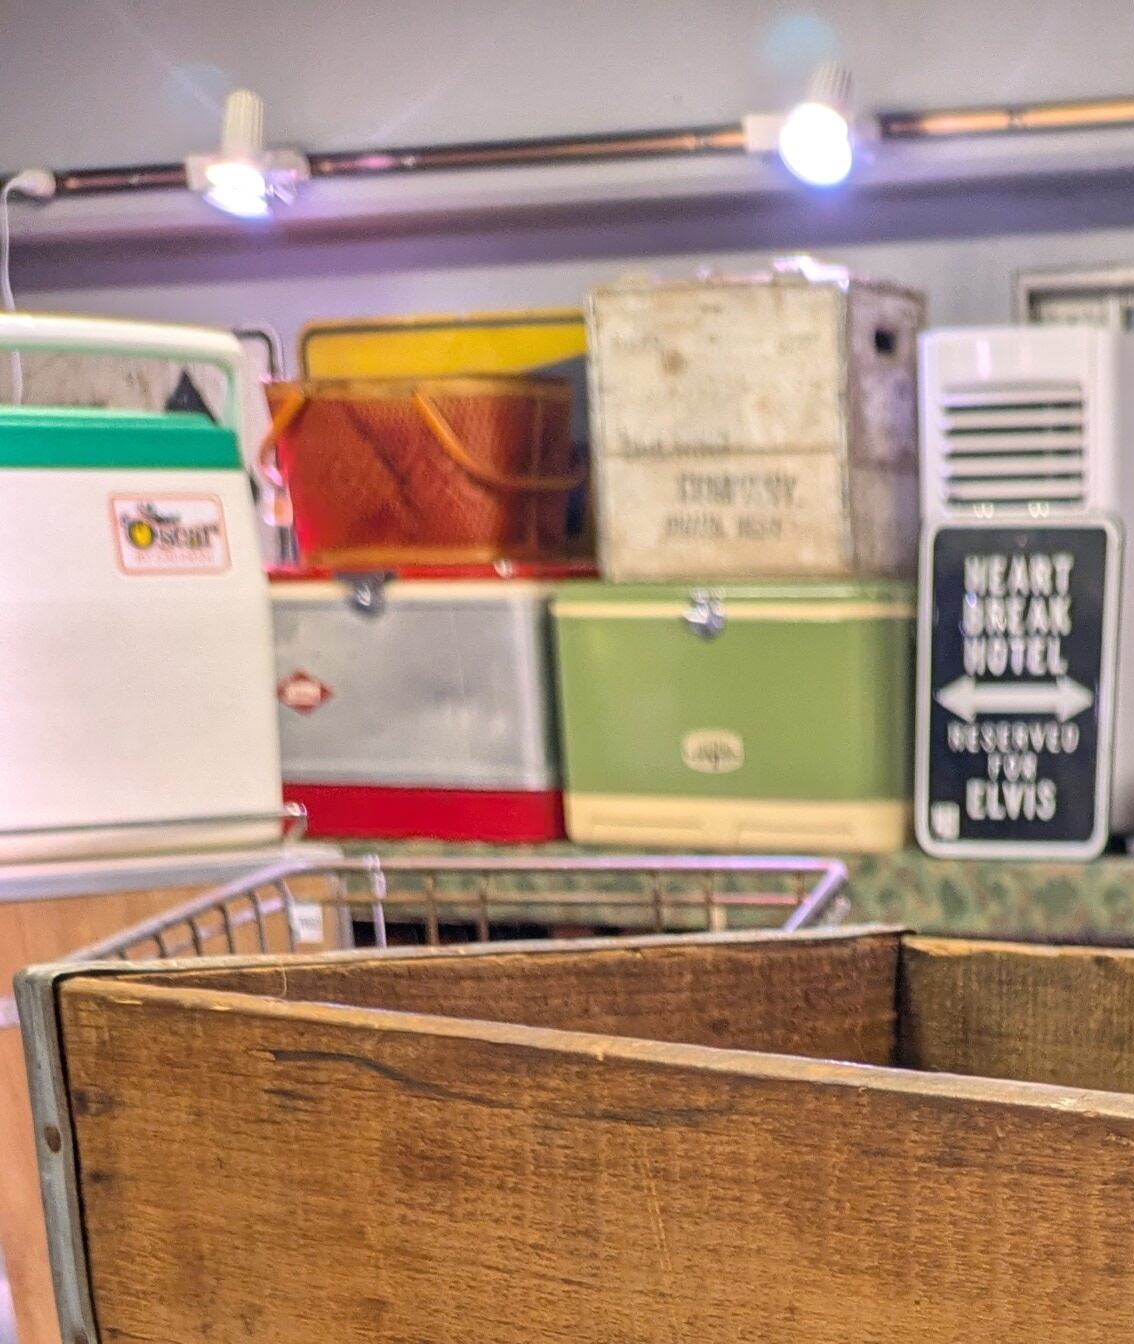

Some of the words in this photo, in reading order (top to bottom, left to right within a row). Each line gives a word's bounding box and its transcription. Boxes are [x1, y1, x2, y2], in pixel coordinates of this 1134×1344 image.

[964, 552, 1075, 598] HEART
[963, 595, 1072, 638] BREAK
[963, 634, 1068, 677] HOTEL
[947, 719, 1080, 754] RESERVED
[987, 750, 1038, 783] FOR
[966, 778, 1057, 832] ELVIS
